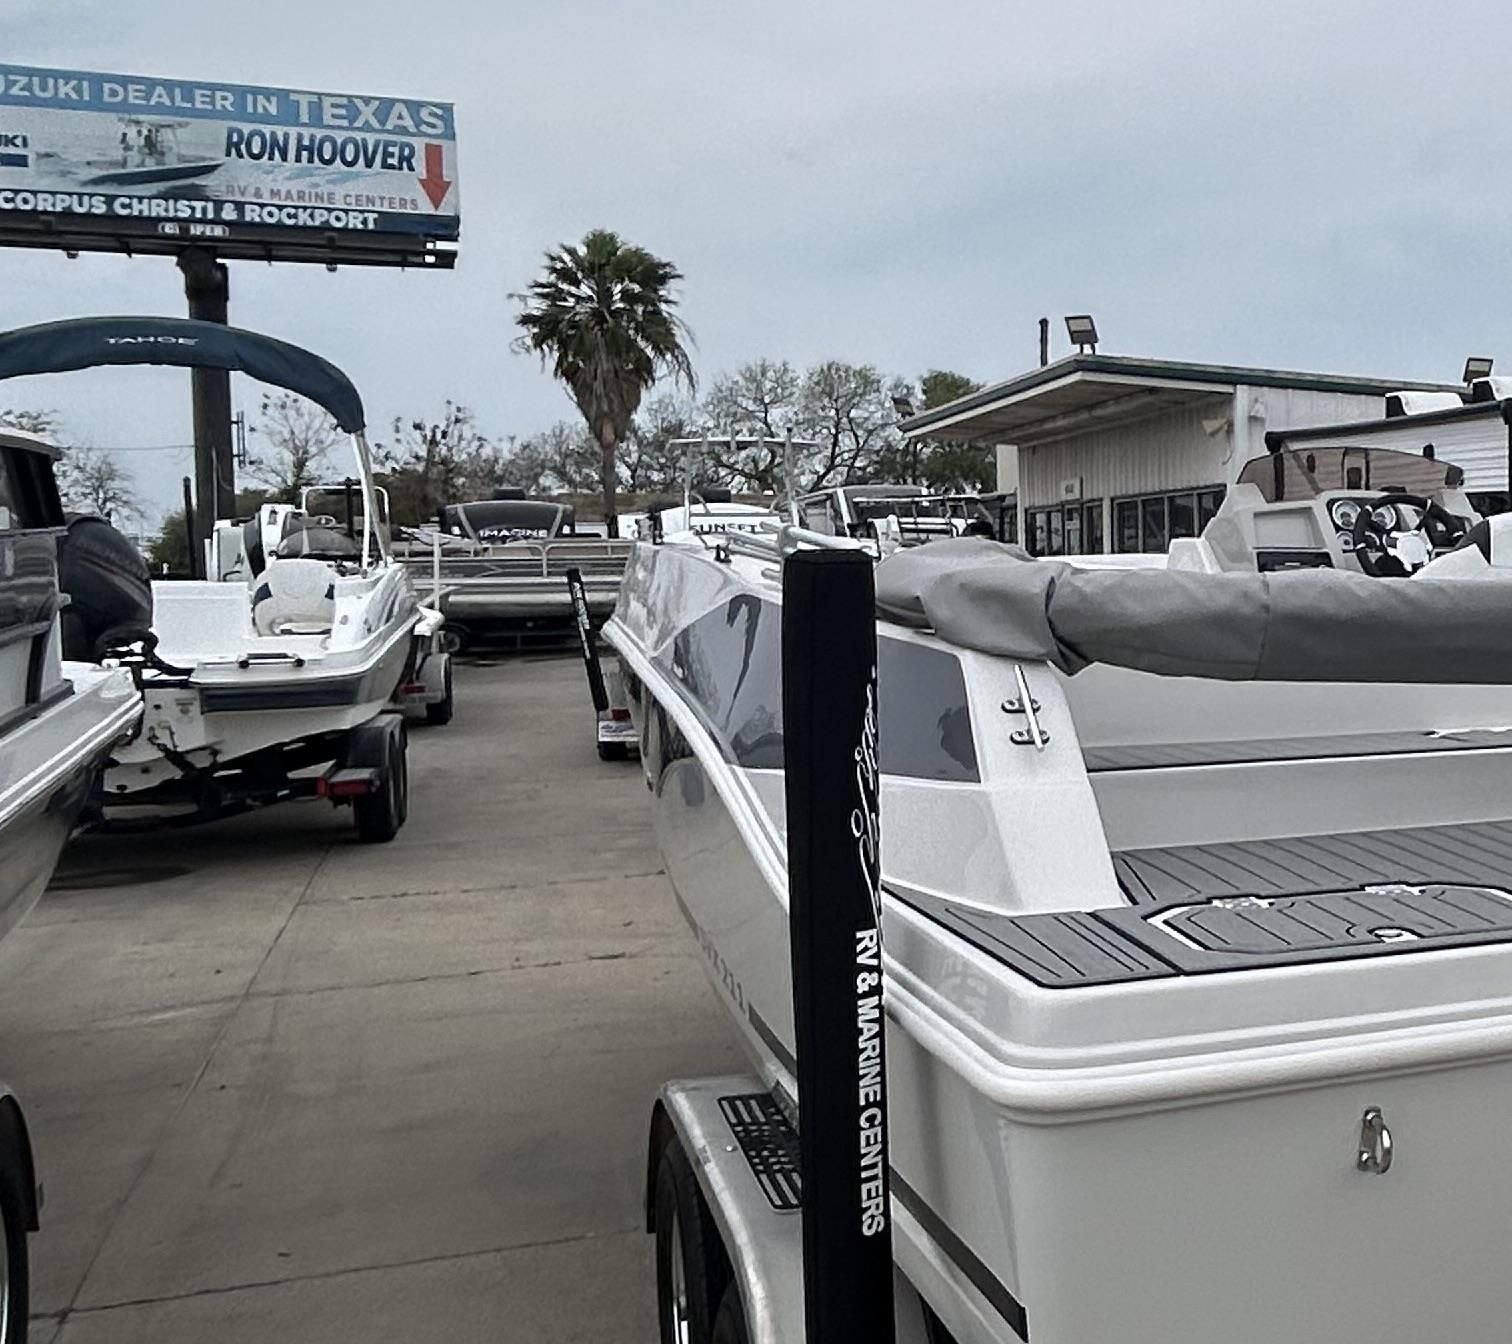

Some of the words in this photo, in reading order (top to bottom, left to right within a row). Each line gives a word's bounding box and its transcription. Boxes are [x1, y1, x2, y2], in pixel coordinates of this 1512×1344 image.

[0, 73, 90, 101] ZUKI
[102, 82, 235, 112] DEALER
[246, 94, 278, 116] IN
[288, 92, 445, 136] TEXAS
[225, 126, 289, 163] RON
[295, 133, 416, 173] HOOVER
[0, 190, 107, 215] CORPUS
[112, 197, 215, 220] CHRISTI
[220, 202, 239, 221] &
[244, 203, 379, 231] ROCKPORT
[225, 183, 248, 198] RV
[253, 185, 264, 200] &
[270, 188, 336, 205] MARINE
[343, 194, 419, 211] CENTERS
[105, 335, 199, 346] TAHOE
[855, 928, 879, 967] RV
[856, 970, 880, 995] &
[856, 996, 882, 1107] MARINE
[859, 1106, 886, 1237] CENTERS
